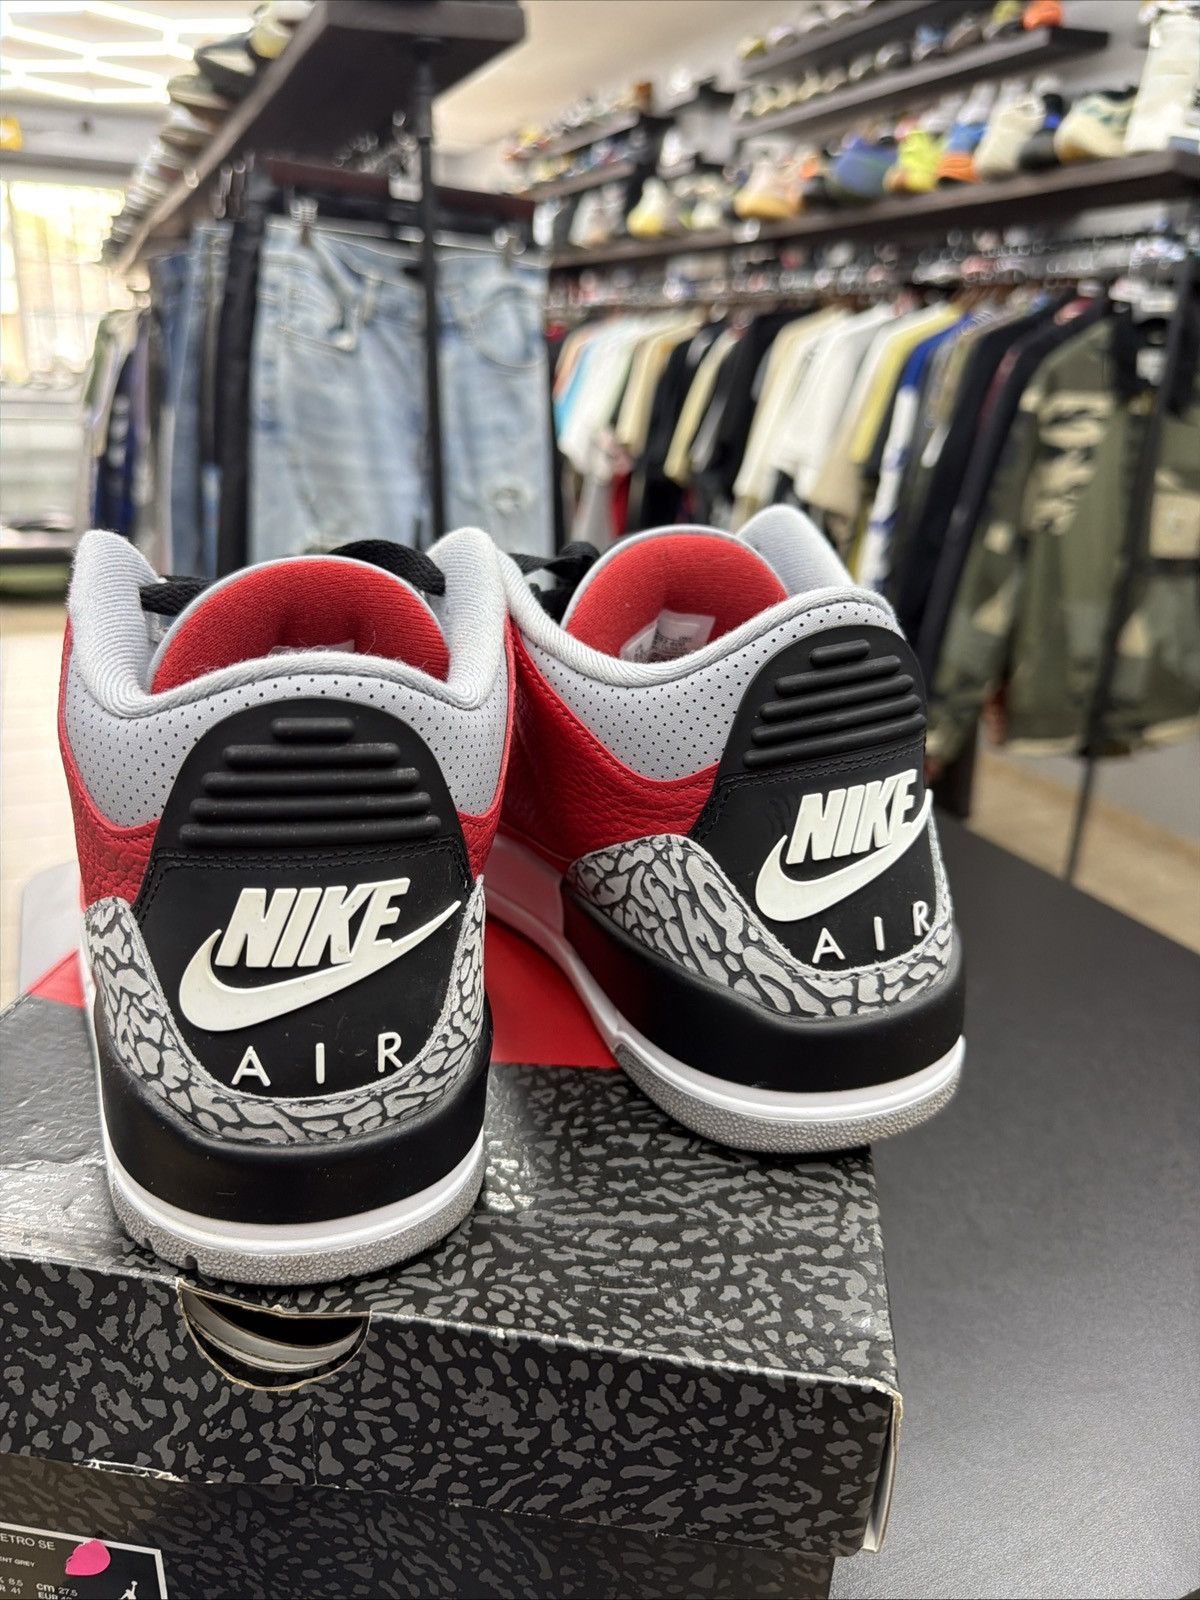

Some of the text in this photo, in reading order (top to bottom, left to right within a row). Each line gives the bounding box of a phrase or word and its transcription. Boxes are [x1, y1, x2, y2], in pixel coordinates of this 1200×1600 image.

[785, 768, 918, 865] NIKE
[214, 876, 411, 968] NIKE
[812, 900, 931, 964] AIR
[231, 1031, 403, 1087] AIR
[38, 1539, 56, 1551] SE
[14, 1558, 35, 1568] GREY
[10, 1586, 21, 1595] 41
[36, 1583, 55, 1593] cm
